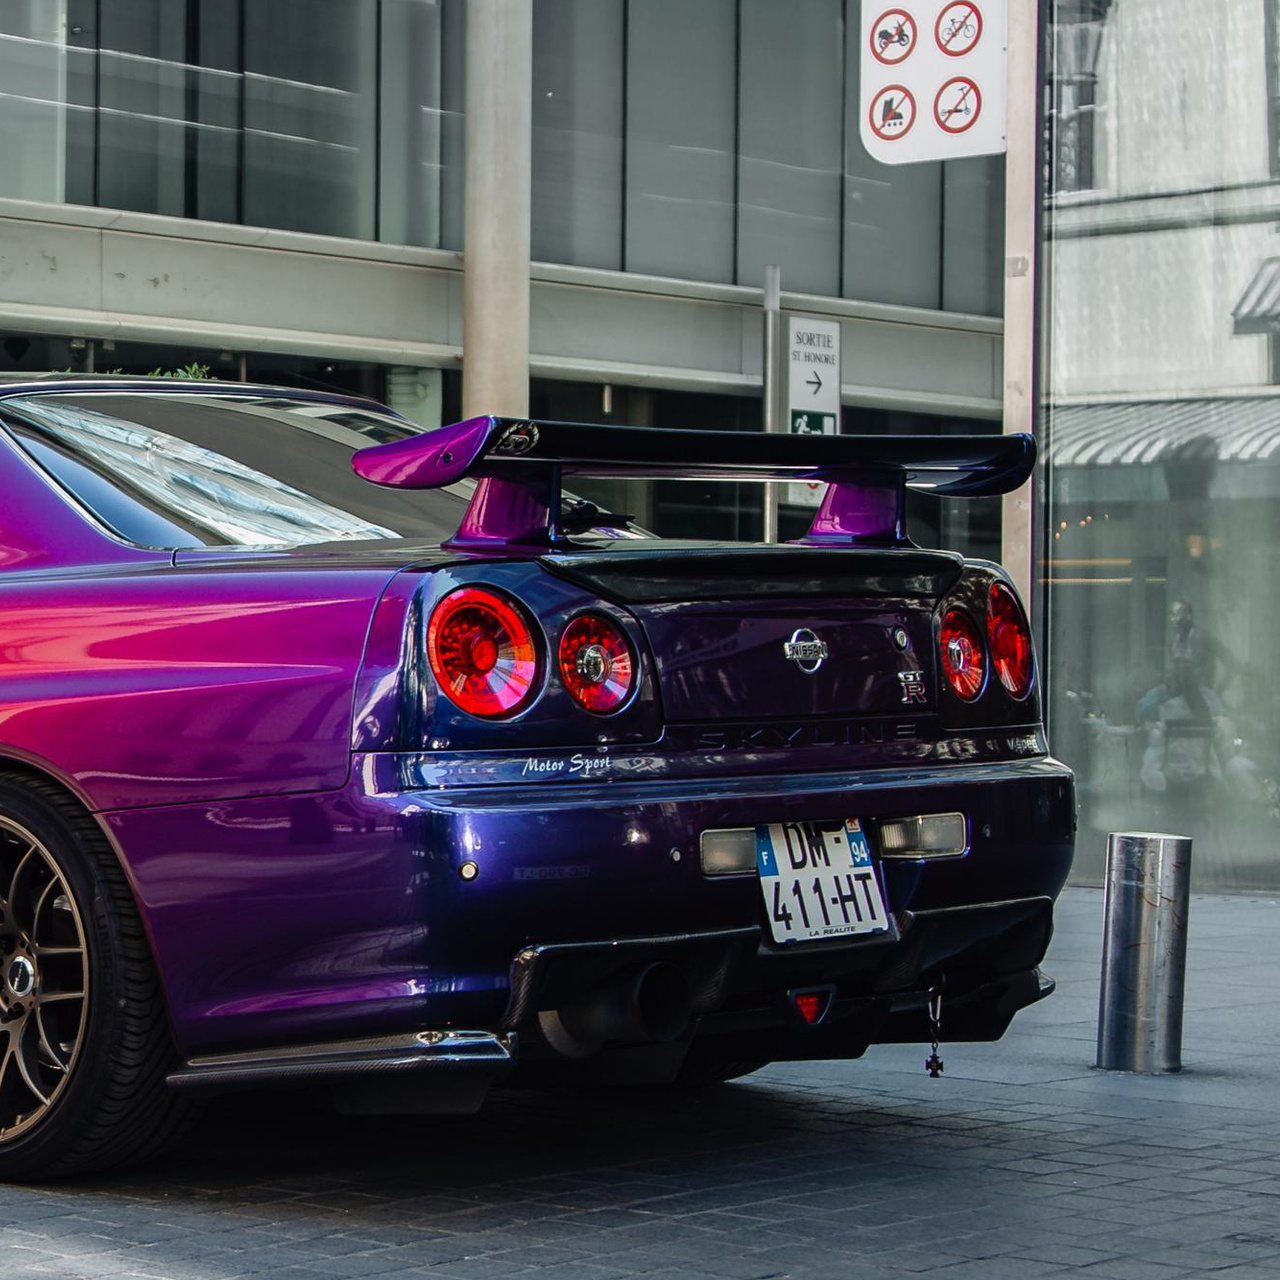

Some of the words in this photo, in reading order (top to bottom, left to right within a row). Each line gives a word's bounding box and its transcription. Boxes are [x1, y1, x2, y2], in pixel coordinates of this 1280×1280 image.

[795, 331, 833, 348] SORTIE
[789, 643, 828, 656] NISSAN
[695, 723, 921, 751] SKYLINE
[522, 757, 565, 776] Motor
[568, 753, 612, 775] Sport
[761, 851, 769, 866] F
[851, 841, 869, 864] 94
[773, 872, 877, 931] 411-HT
[823, 926, 856, 935] REALITE
